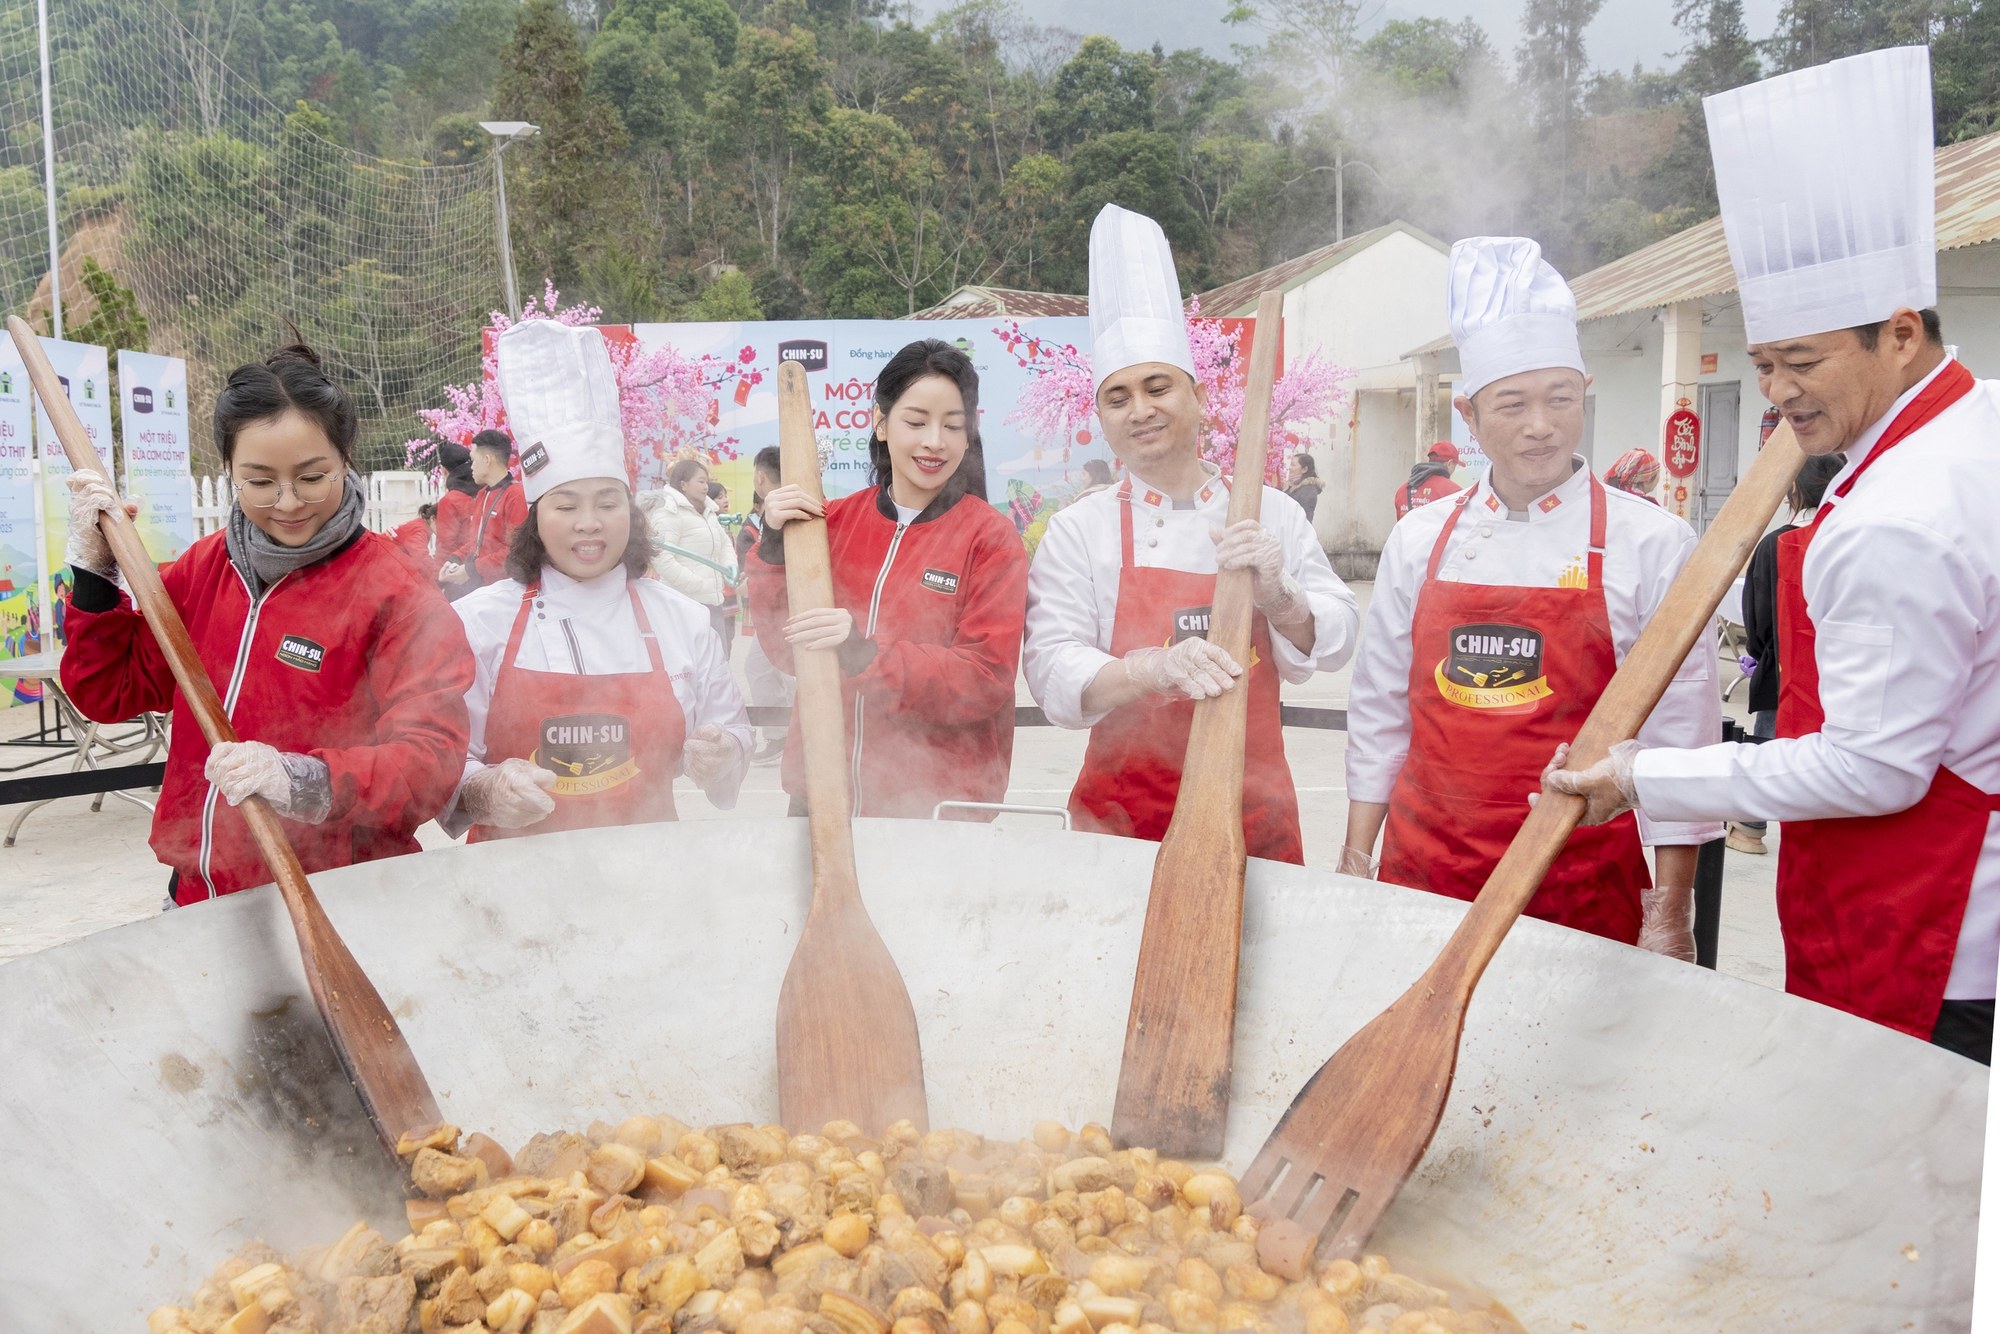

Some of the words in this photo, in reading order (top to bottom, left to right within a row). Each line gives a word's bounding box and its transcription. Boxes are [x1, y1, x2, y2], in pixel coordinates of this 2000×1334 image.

[782, 348, 823, 360] CHIN-SU
[825, 377, 876, 406] MỘT
[835, 408, 875, 429] CƠ
[1674, 417, 1695, 436] Tết
[139, 429, 155, 447] MỘT
[157, 430, 177, 447] TRIỆU
[8, 446, 26, 461] THỊT
[132, 446, 146, 460] BỮA
[147, 449, 162, 460] CƠM
[172, 451, 185, 464] THỊT
[523, 448, 546, 468] CHIN-SU
[14, 468, 28, 476] cao
[924, 572, 957, 588] CHIN-SU
[1178, 615, 1211, 631] CHI
[282, 640, 321, 661] CHIN-SU
[1455, 634, 1537, 658] CHIN-SU
[1445, 684, 1545, 705] PROFESSIONAL
[546, 724, 624, 745] CHIN-SU
[552, 767, 634, 792] OFESSIONAL
